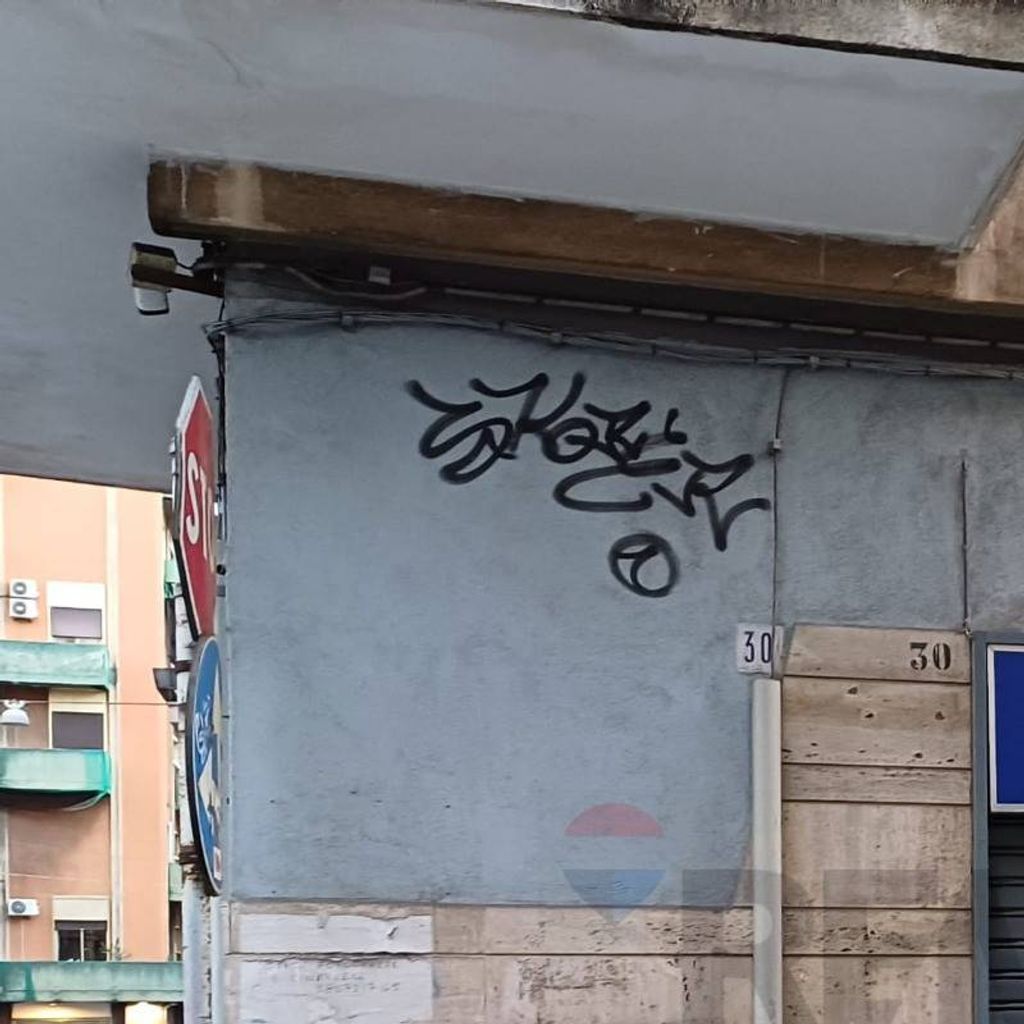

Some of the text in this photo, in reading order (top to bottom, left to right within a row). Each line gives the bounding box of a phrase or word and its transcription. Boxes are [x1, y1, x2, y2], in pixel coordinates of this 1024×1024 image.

[186, 451, 214, 573] ST
[744, 631, 771, 664] 30
[909, 642, 951, 670] 30
